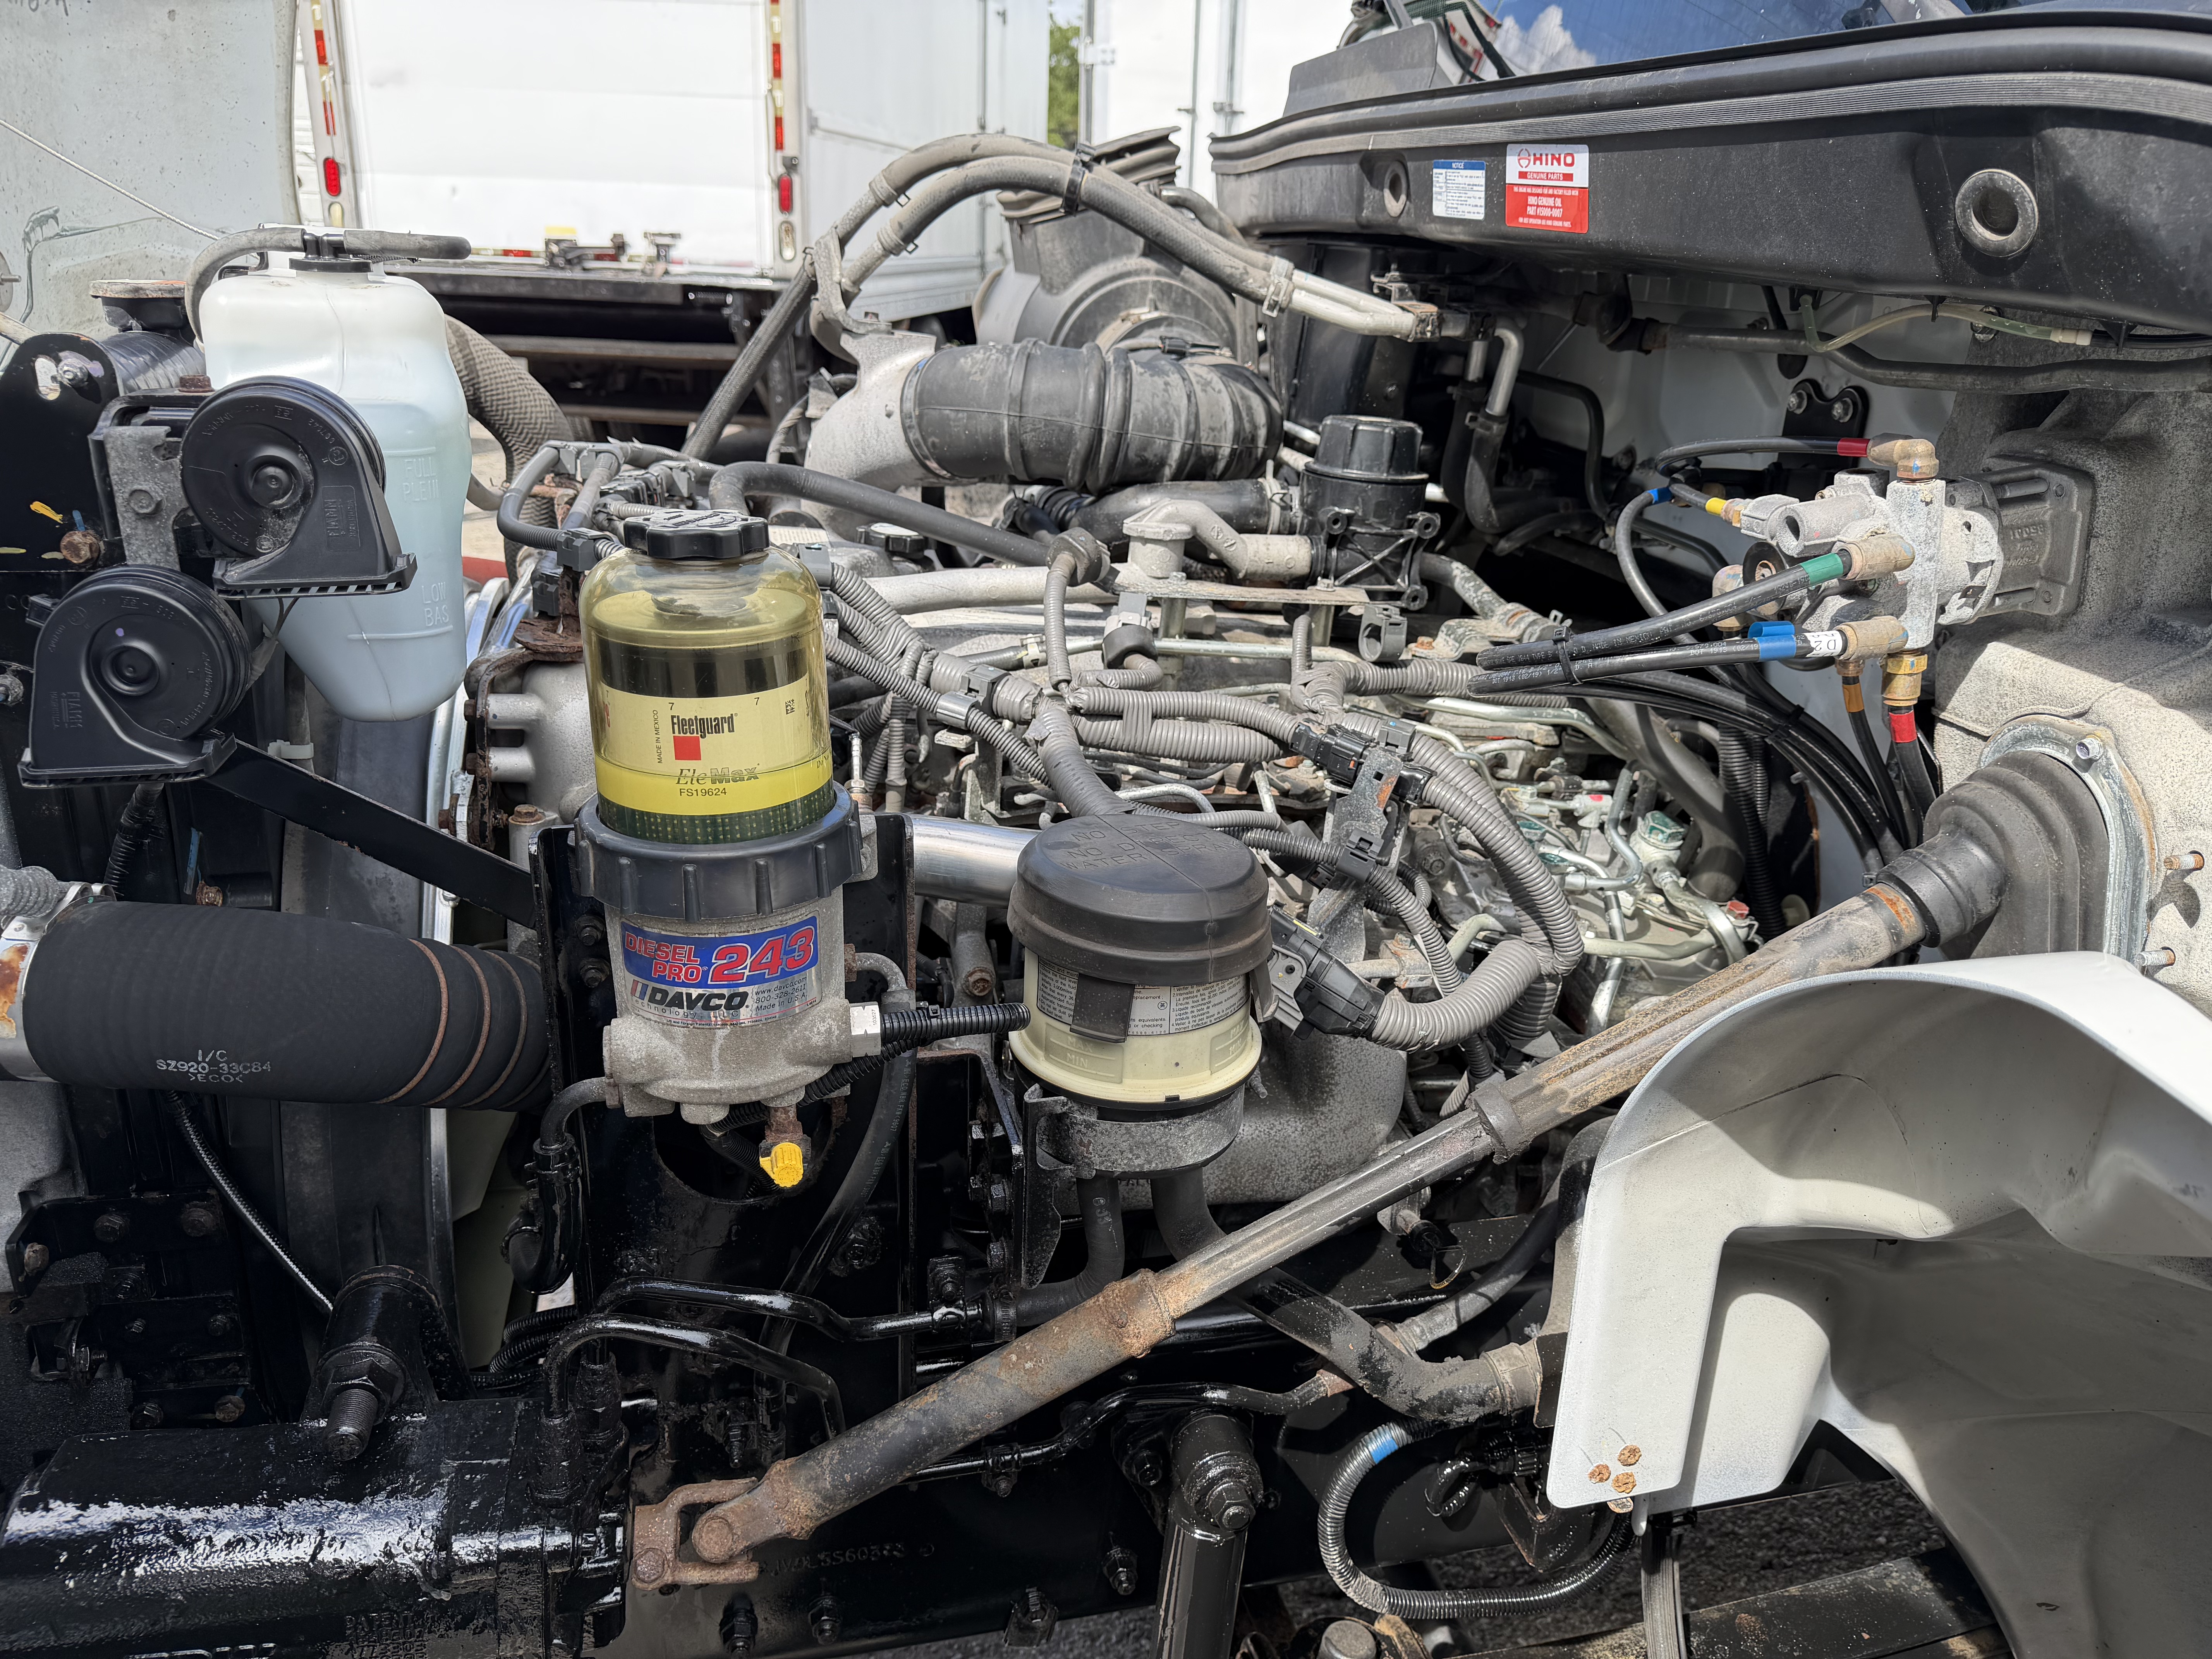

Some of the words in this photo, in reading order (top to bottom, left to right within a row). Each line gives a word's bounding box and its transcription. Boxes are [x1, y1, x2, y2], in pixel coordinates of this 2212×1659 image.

[1533, 153, 1575, 167] HINO
[1527, 206, 1536, 215] PART
[1528, 196, 1537, 204] HINO
[1538, 196, 1554, 206] GENUINE
[404, 457, 436, 477] FULL
[422, 582, 446, 603] LOW
[424, 605, 449, 626] BAS
[1592, 642, 1609, 652] MADE
[1626, 633, 1653, 644] MEXICO
[754, 697, 759, 705] 7
[679, 788, 727, 797] FS19624
[1072, 831, 1106, 842] NO
[1120, 821, 1179, 834] STEP
[1061, 853, 1148, 869] WATER
[1161, 841, 1239, 856] SPRAY
[1067, 848, 1103, 859] NO
[1117, 832, 1211, 852] DIRECT
[625, 931, 700, 964] DIESEL
[708, 926, 815, 984] 243
[652, 960, 702, 983] PRO
[755, 976, 807, 996] www.davco.com
[756, 984, 806, 1004] 800-328-2611
[648, 986, 749, 1011] DAVCO
[756, 1002, 775, 1012] Made
[778, 1000, 785, 1008] in
[1067, 1036, 1093, 1053] MAX
[198, 1049, 227, 1061] I/C
[1066, 1053, 1089, 1069] MIN
[156, 1059, 272, 1074] SZ920-33C84
